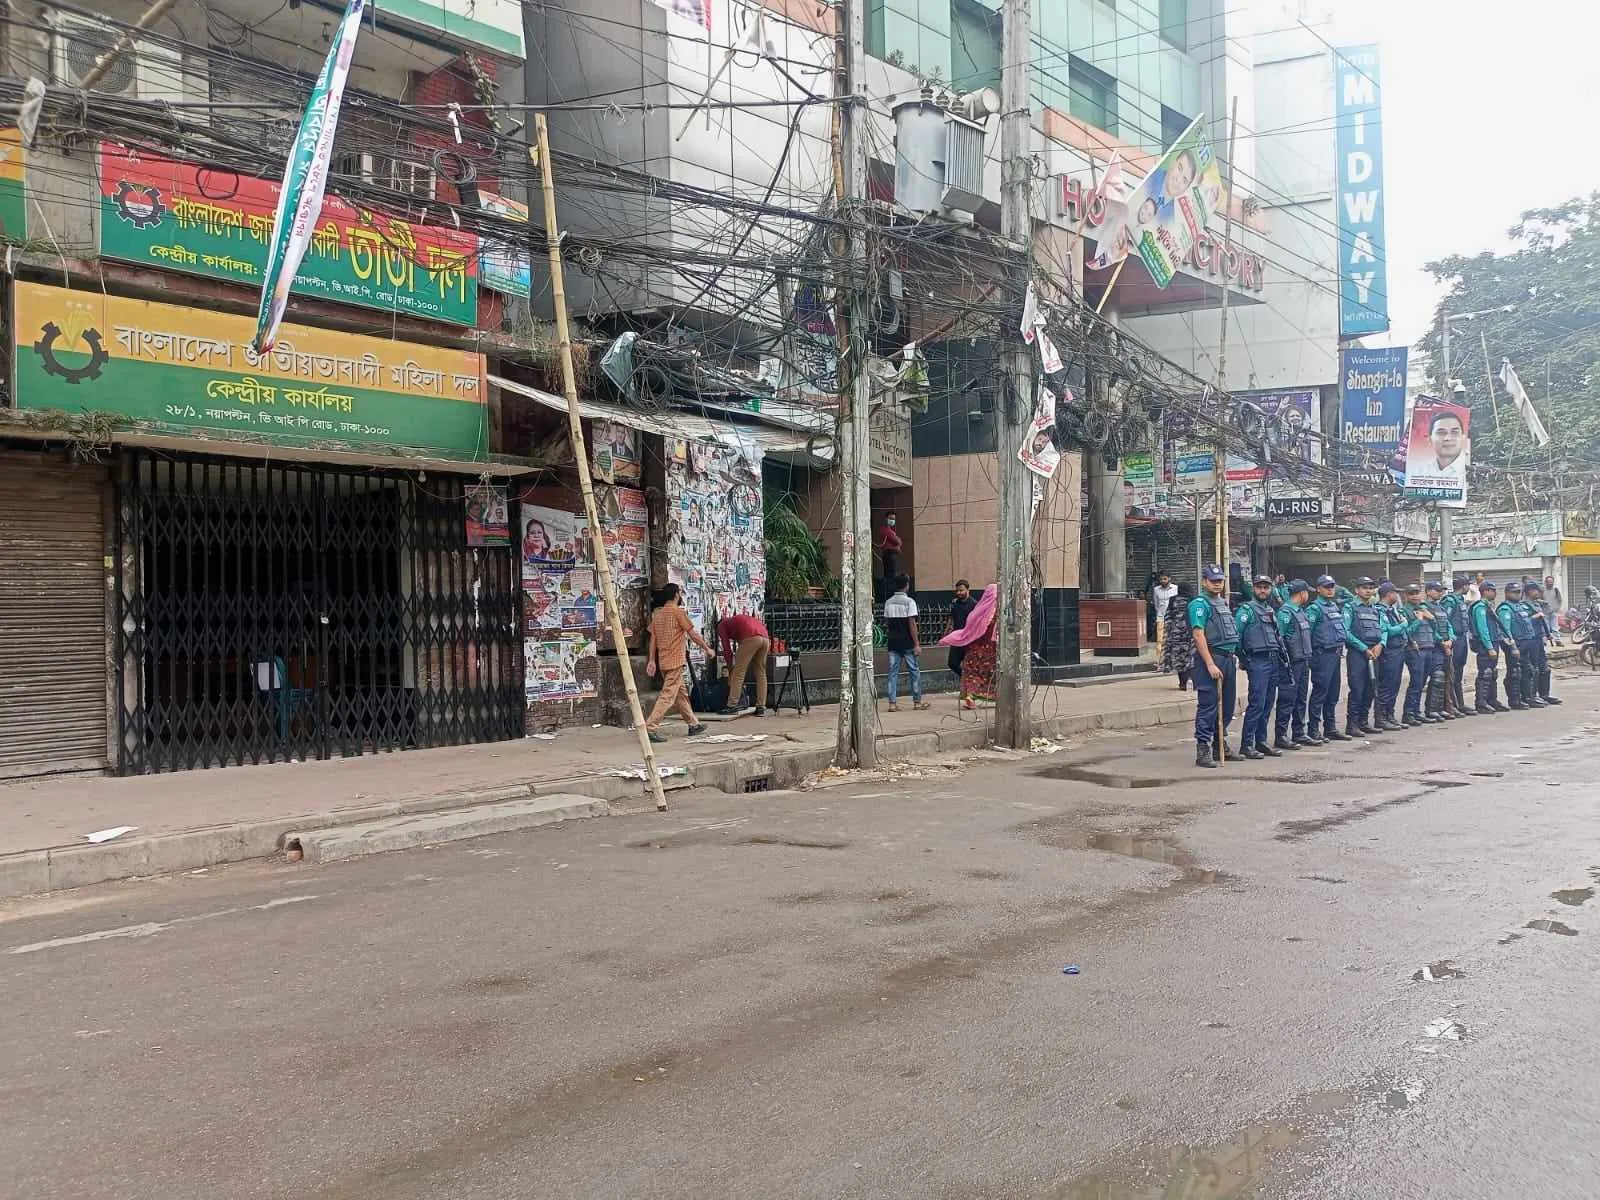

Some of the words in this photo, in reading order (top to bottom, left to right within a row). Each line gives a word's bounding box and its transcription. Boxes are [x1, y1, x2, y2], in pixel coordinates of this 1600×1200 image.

[1343, 73, 1379, 304] MIDWAY
[150, 244, 198, 265] কেন্দ্রীয়
[172, 196, 244, 240] বাংলাদেশ
[426, 245, 466, 303] দল
[113, 324, 236, 367] বাংলাদেশ
[240, 338, 384, 387] জাতীয়তাবাদী
[390, 359, 447, 395] মহিলা
[451, 374, 481, 397] দল
[1351, 355, 1391, 365] Welcome
[206, 376, 278, 406] কেন্দ্রীয়
[282, 387, 355, 413] কার্যালয়
[1366, 396, 1383, 417] Inn
[339, 421, 390, 435] ঢাকা-১০০০
[1344, 421, 1401, 443] Restaurant
[1268, 500, 1320, 515] AJ-RNS
